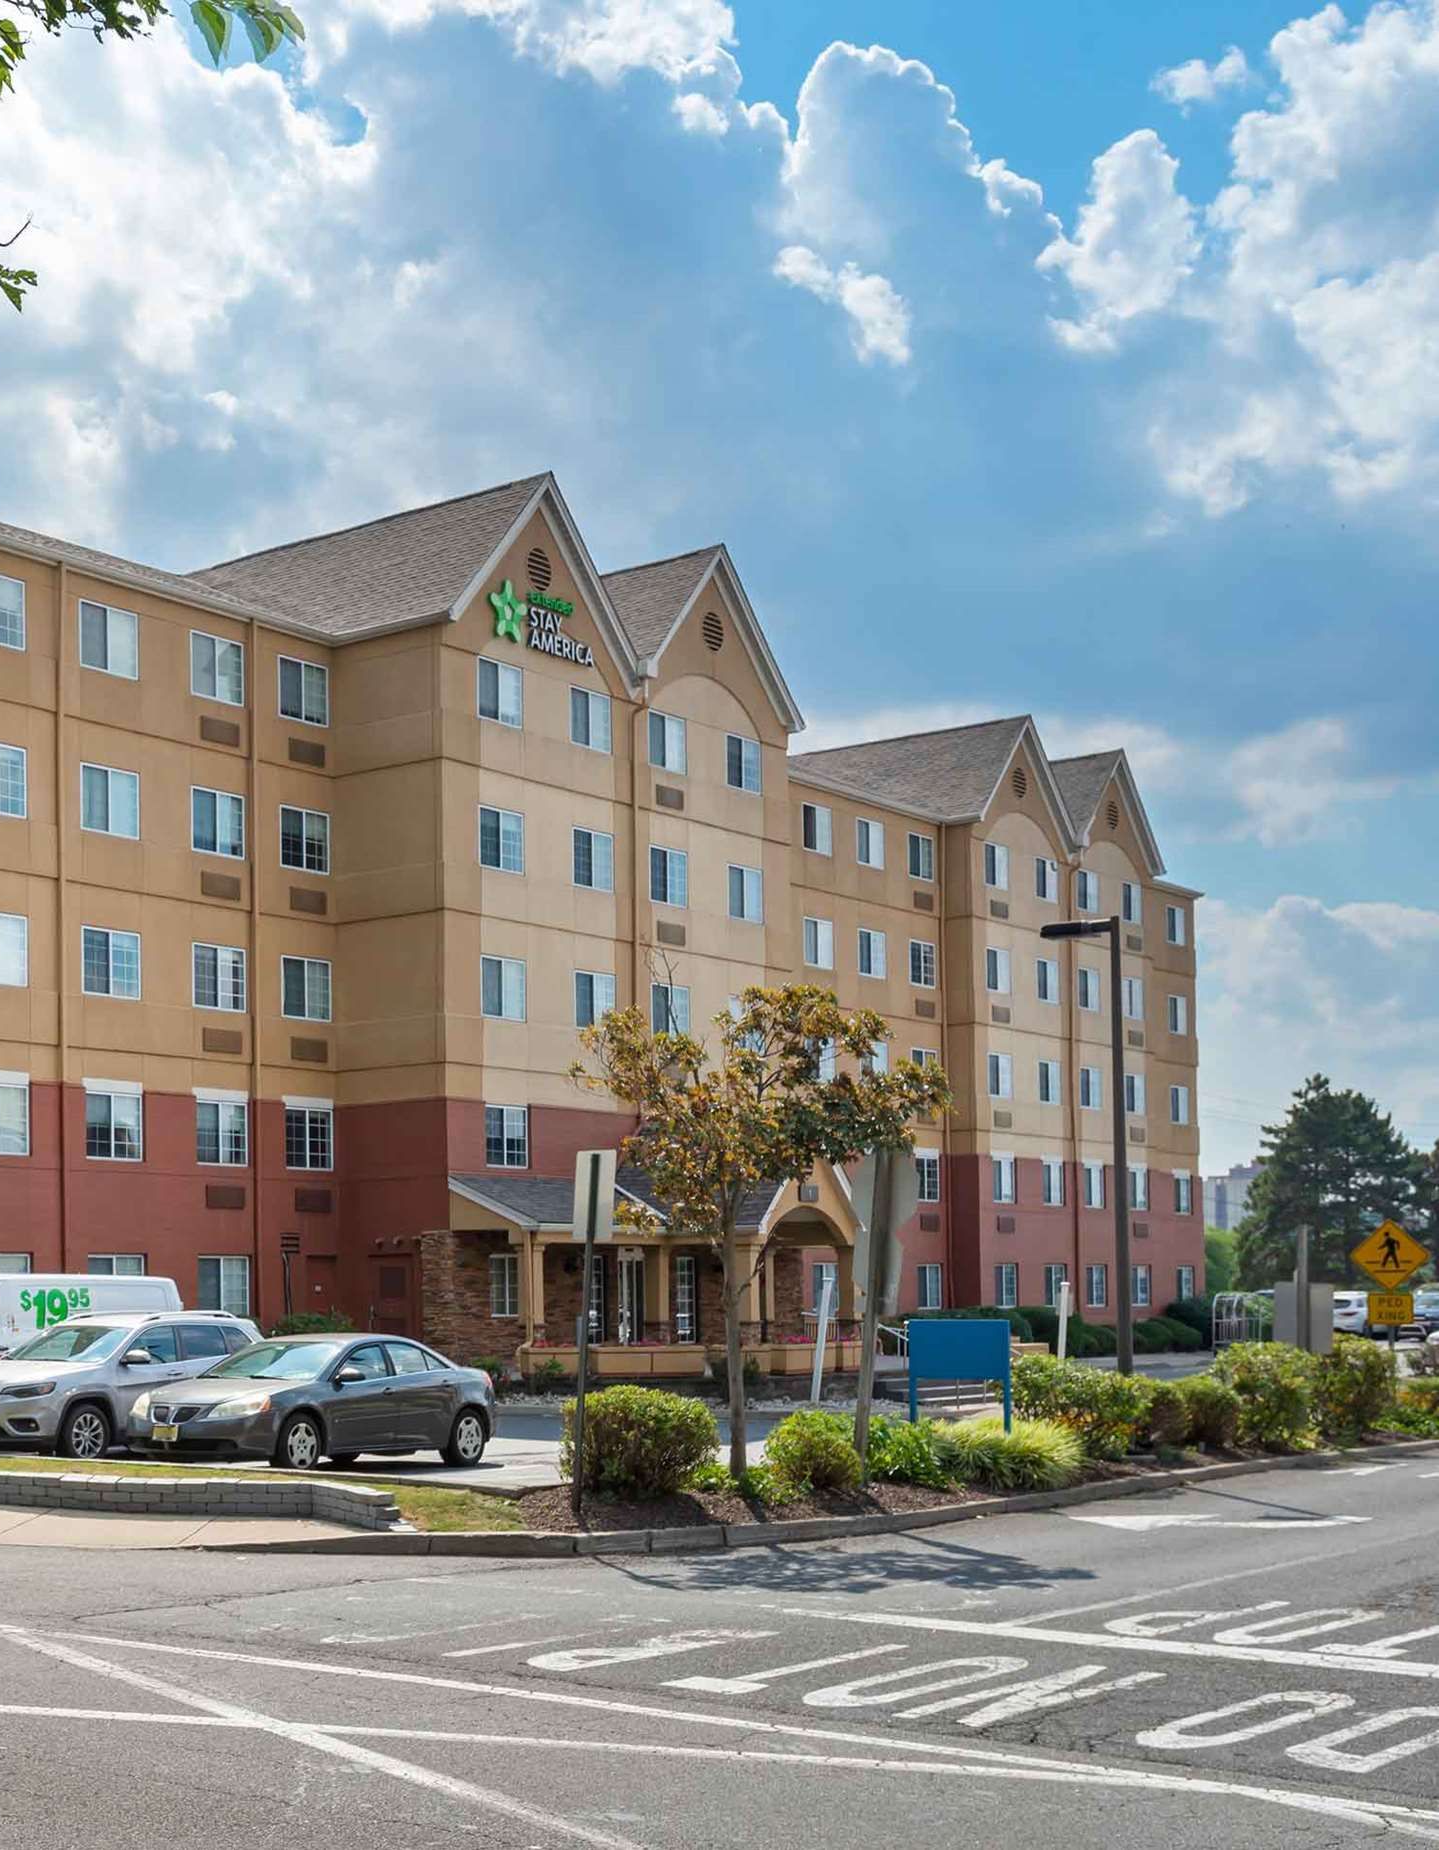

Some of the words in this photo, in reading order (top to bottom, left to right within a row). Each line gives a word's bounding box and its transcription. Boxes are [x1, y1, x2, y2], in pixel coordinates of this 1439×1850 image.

[530, 607, 562, 633] STAY
[531, 629, 594, 666] AMERICA
[1377, 1312, 1405, 1321] XING
[1378, 1297, 1403, 1307] PED
[1104, 1600, 1439, 1659] TOP
[659, 1644, 1168, 1727] NOT
